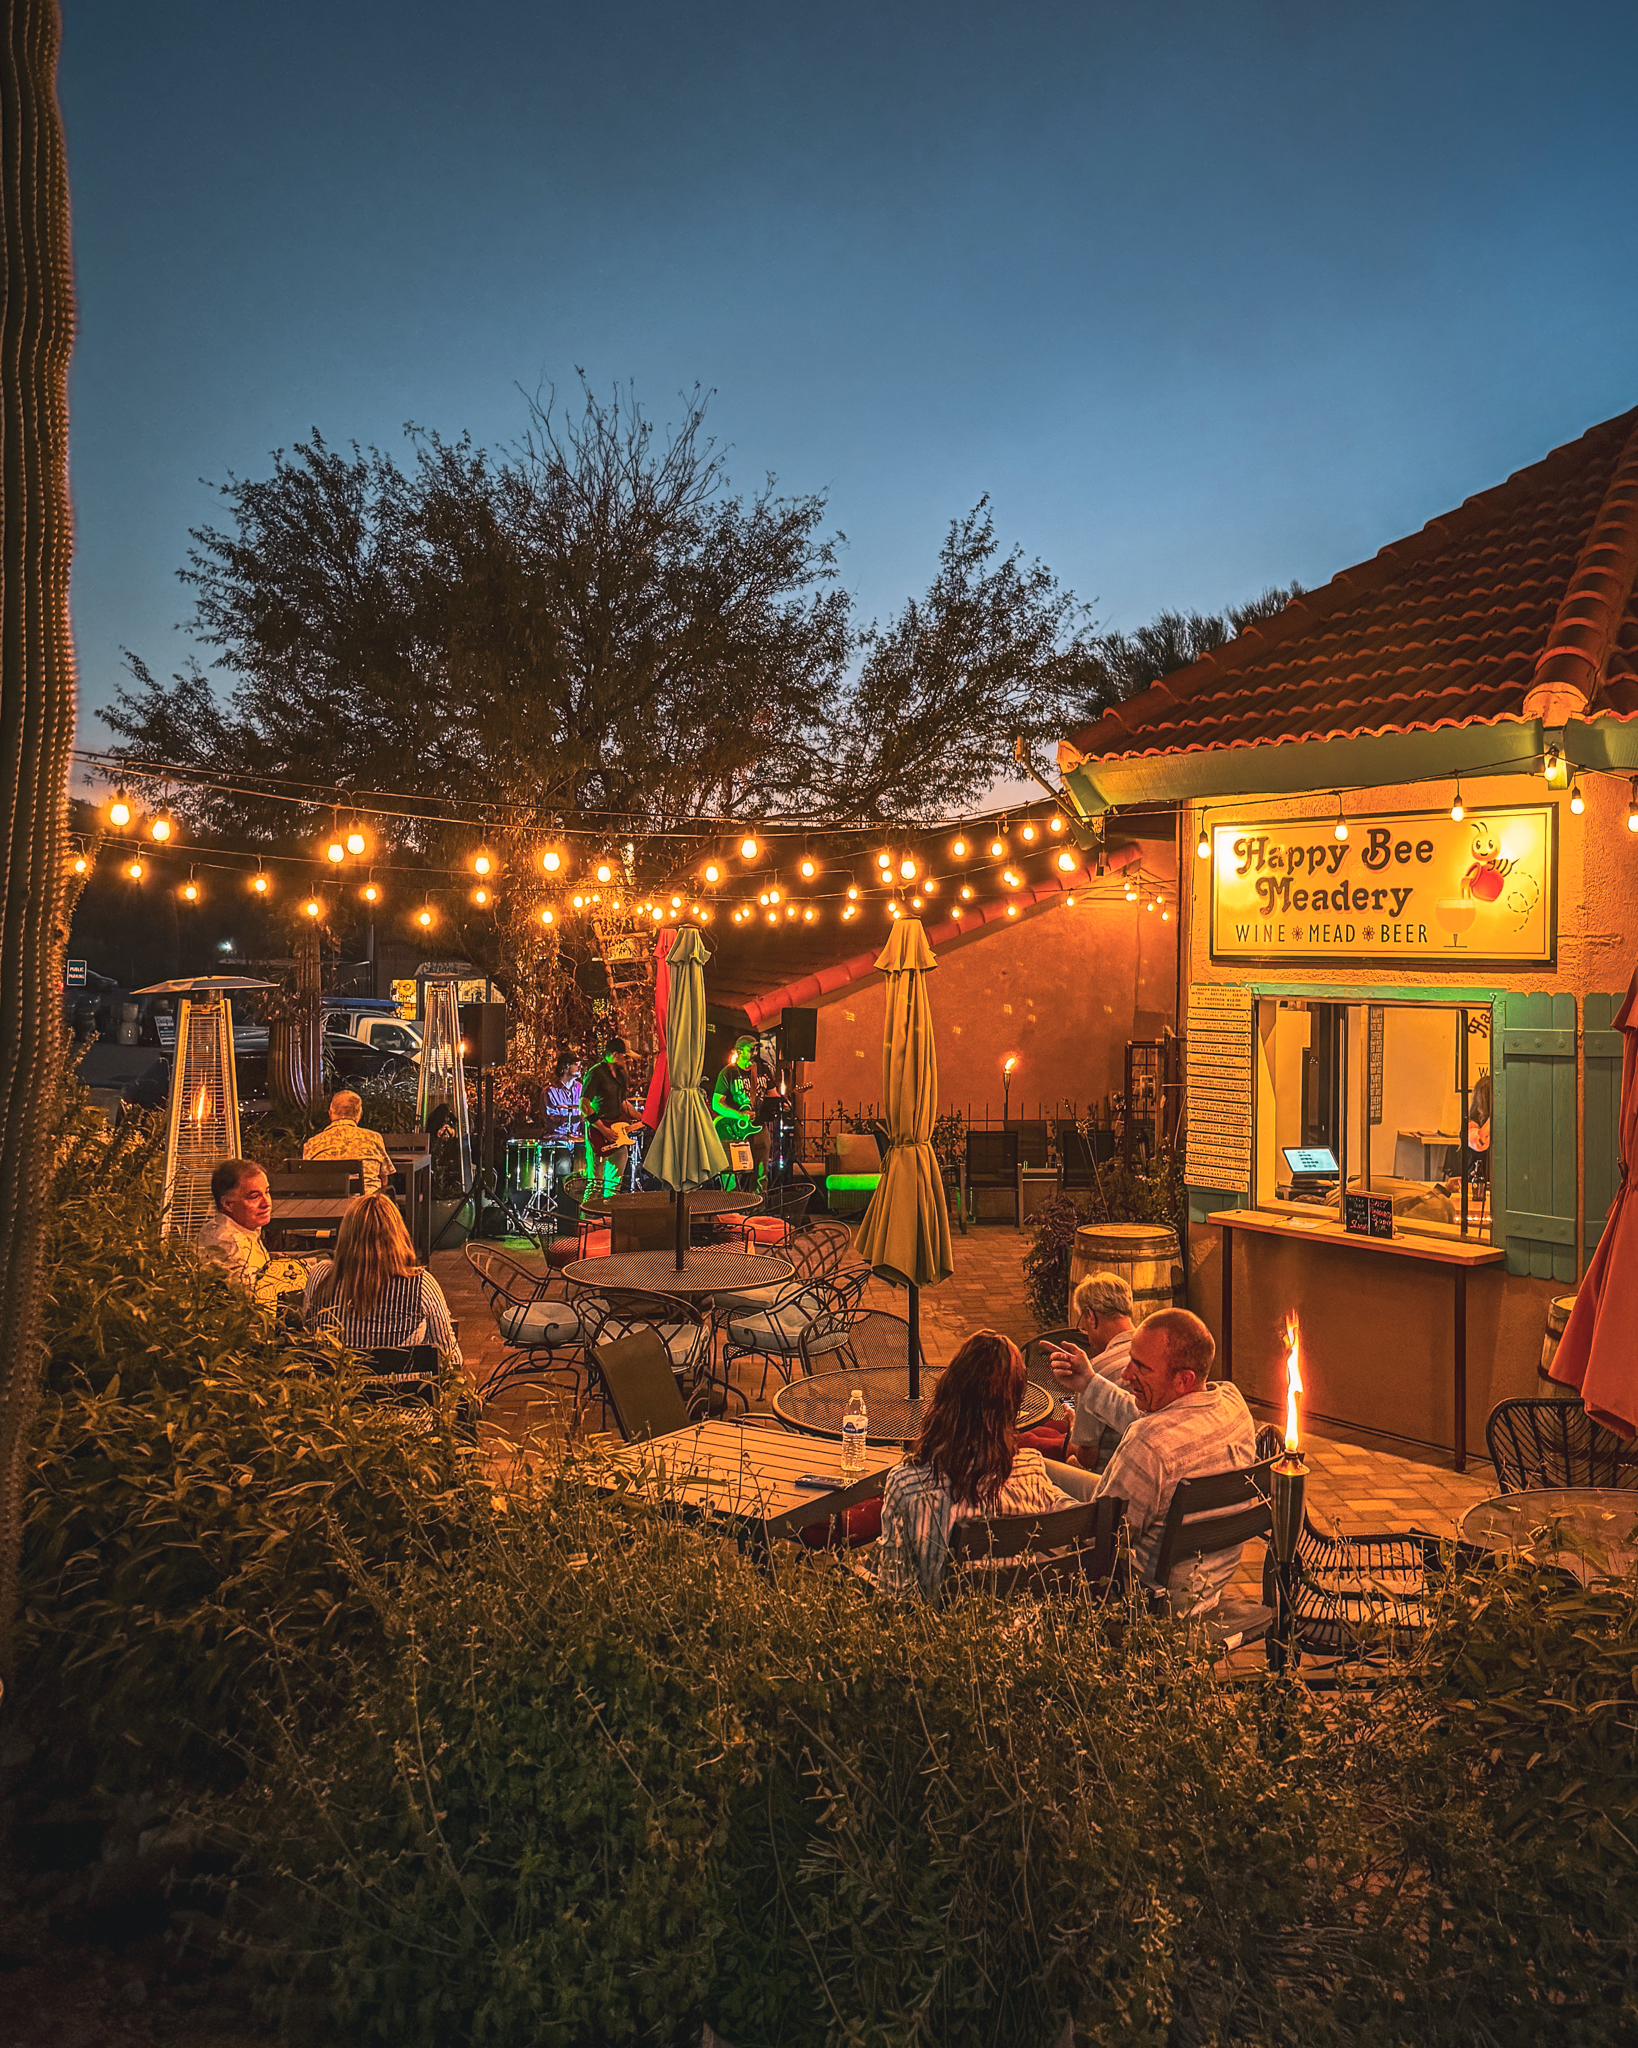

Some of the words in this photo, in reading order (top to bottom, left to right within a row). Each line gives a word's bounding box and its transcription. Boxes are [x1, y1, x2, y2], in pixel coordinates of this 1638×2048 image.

[1233, 836, 1350, 876] Happy
[1362, 828, 1434, 871] Bee
[1256, 876, 1414, 918] Meadery
[1236, 924, 1286, 943] WINE
[1309, 924, 1356, 943] MEAD
[1381, 924, 1428, 943] BEER
